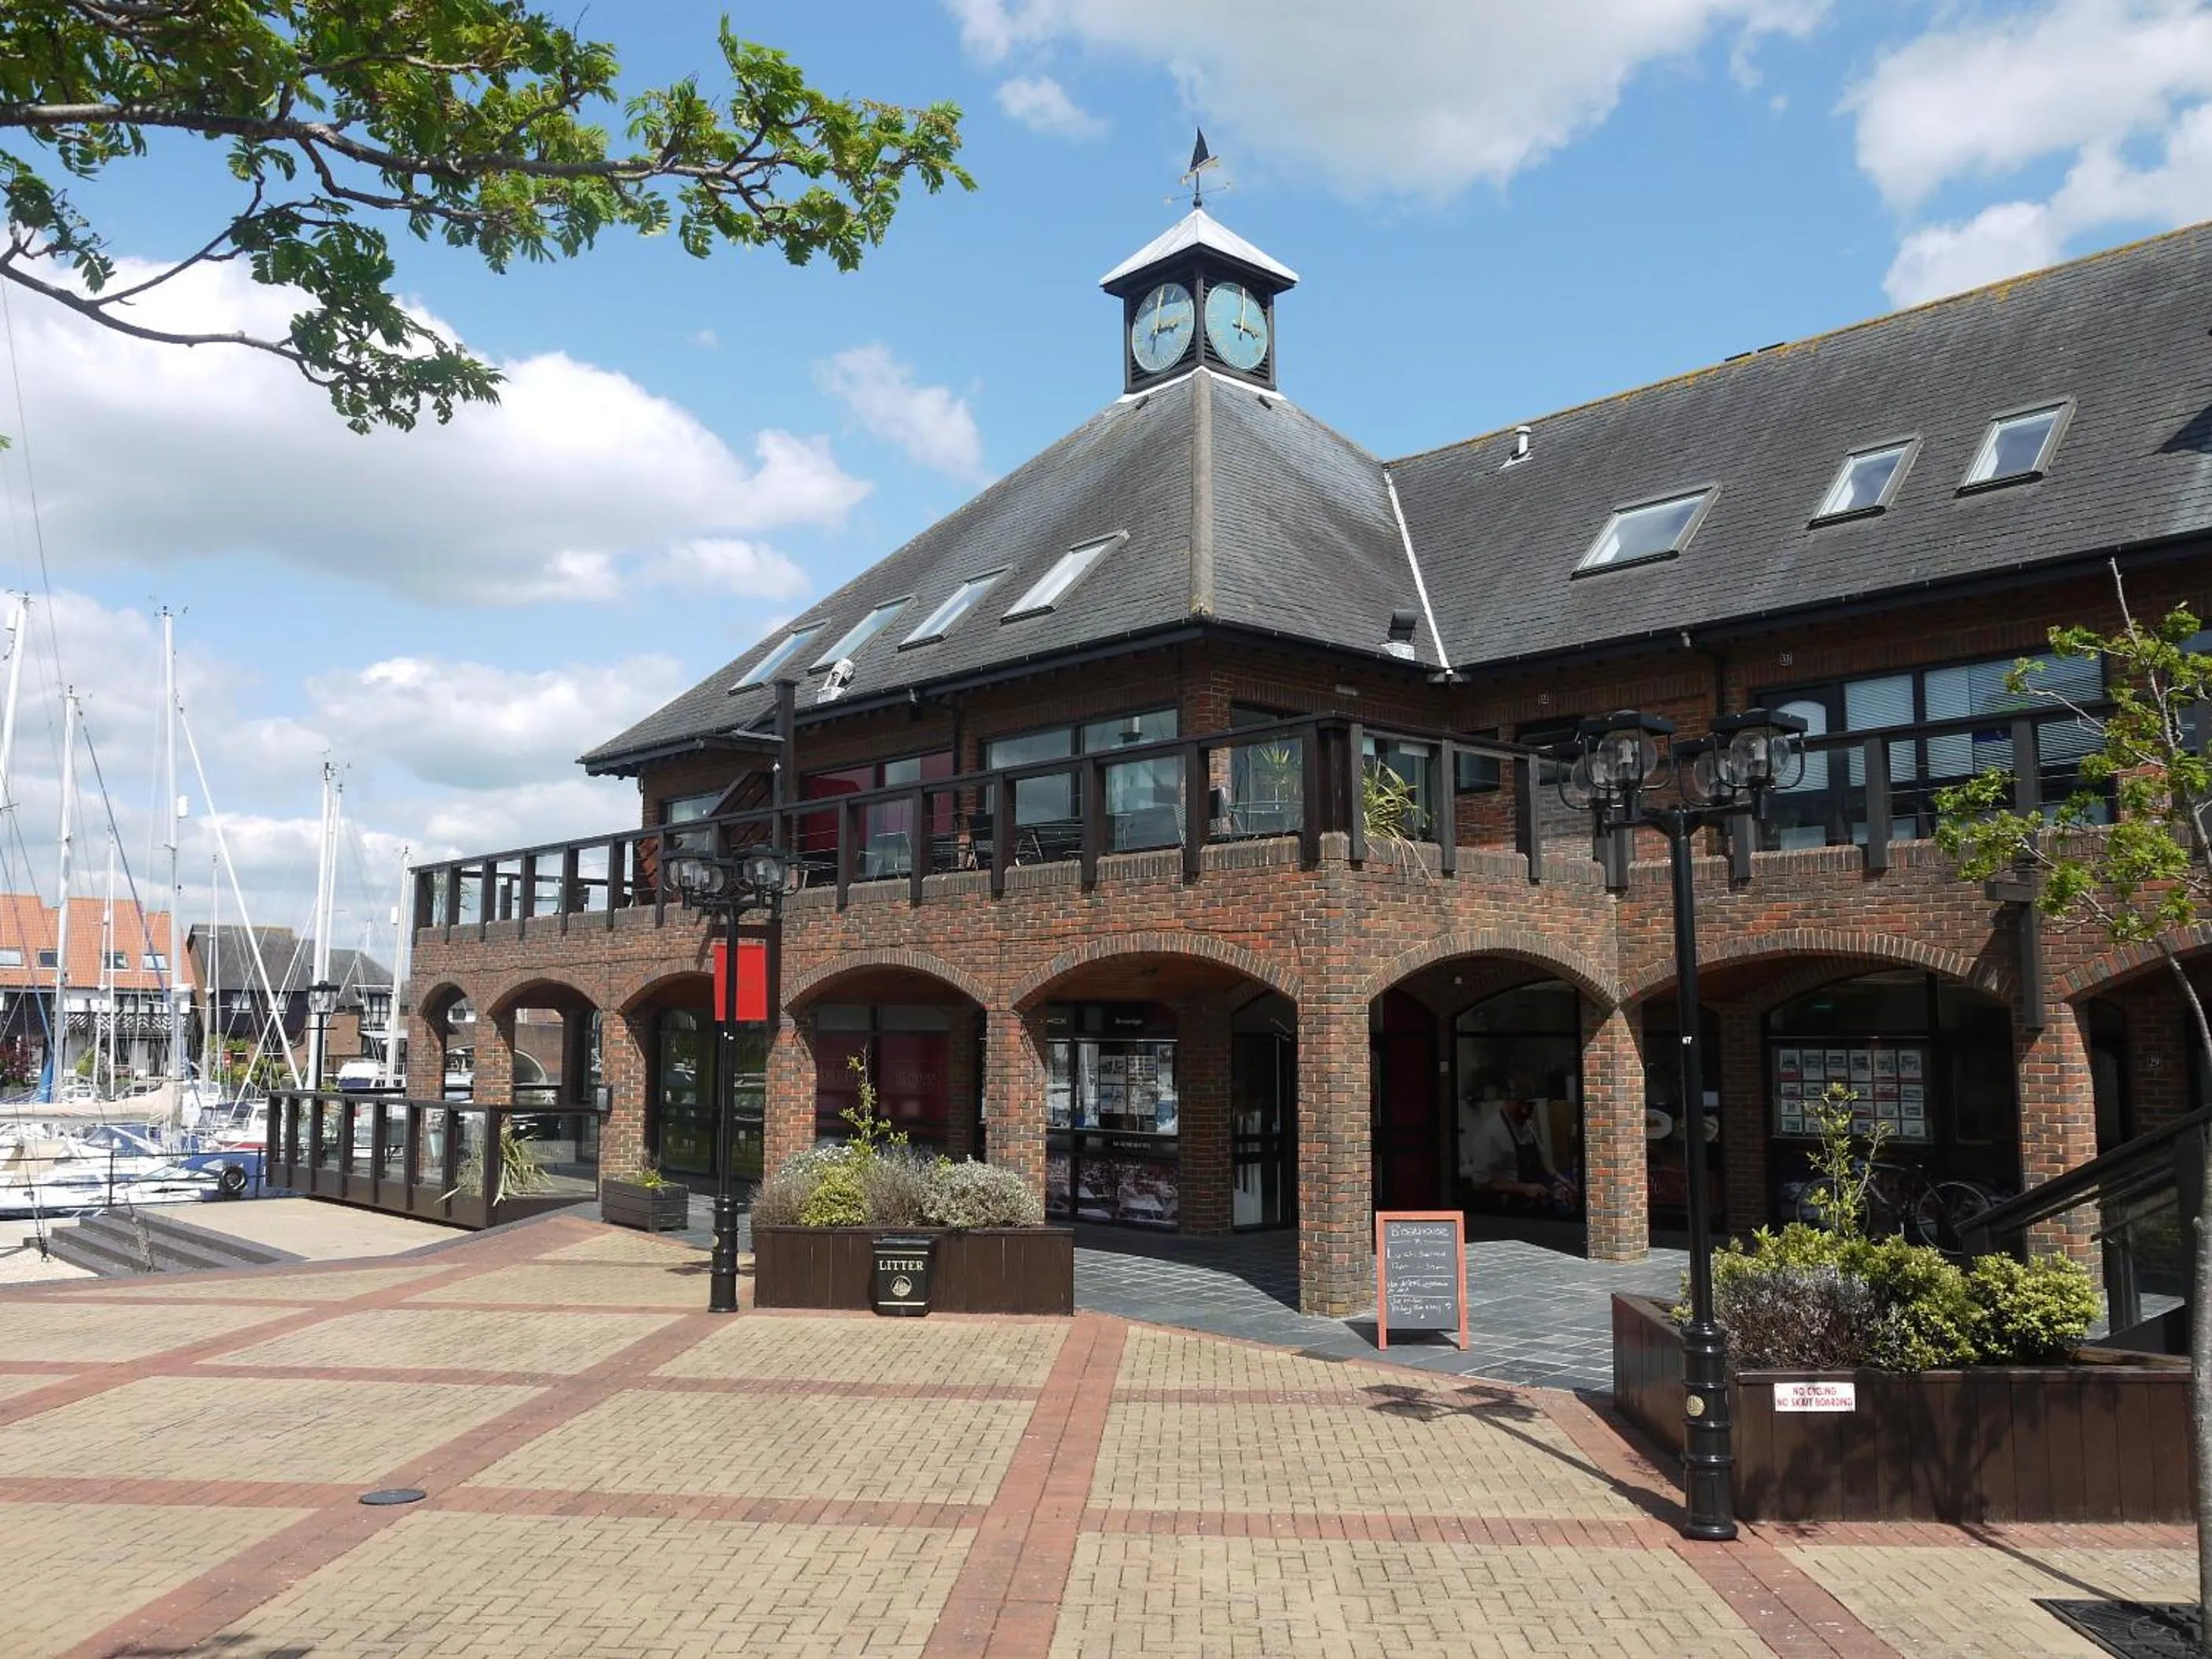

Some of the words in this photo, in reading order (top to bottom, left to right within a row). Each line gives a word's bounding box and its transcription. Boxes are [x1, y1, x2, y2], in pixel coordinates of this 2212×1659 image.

[878, 1260, 924, 1270] LITTER
[1793, 1387, 1804, 1396] NO
[1807, 1387, 1837, 1396] CYCLING
